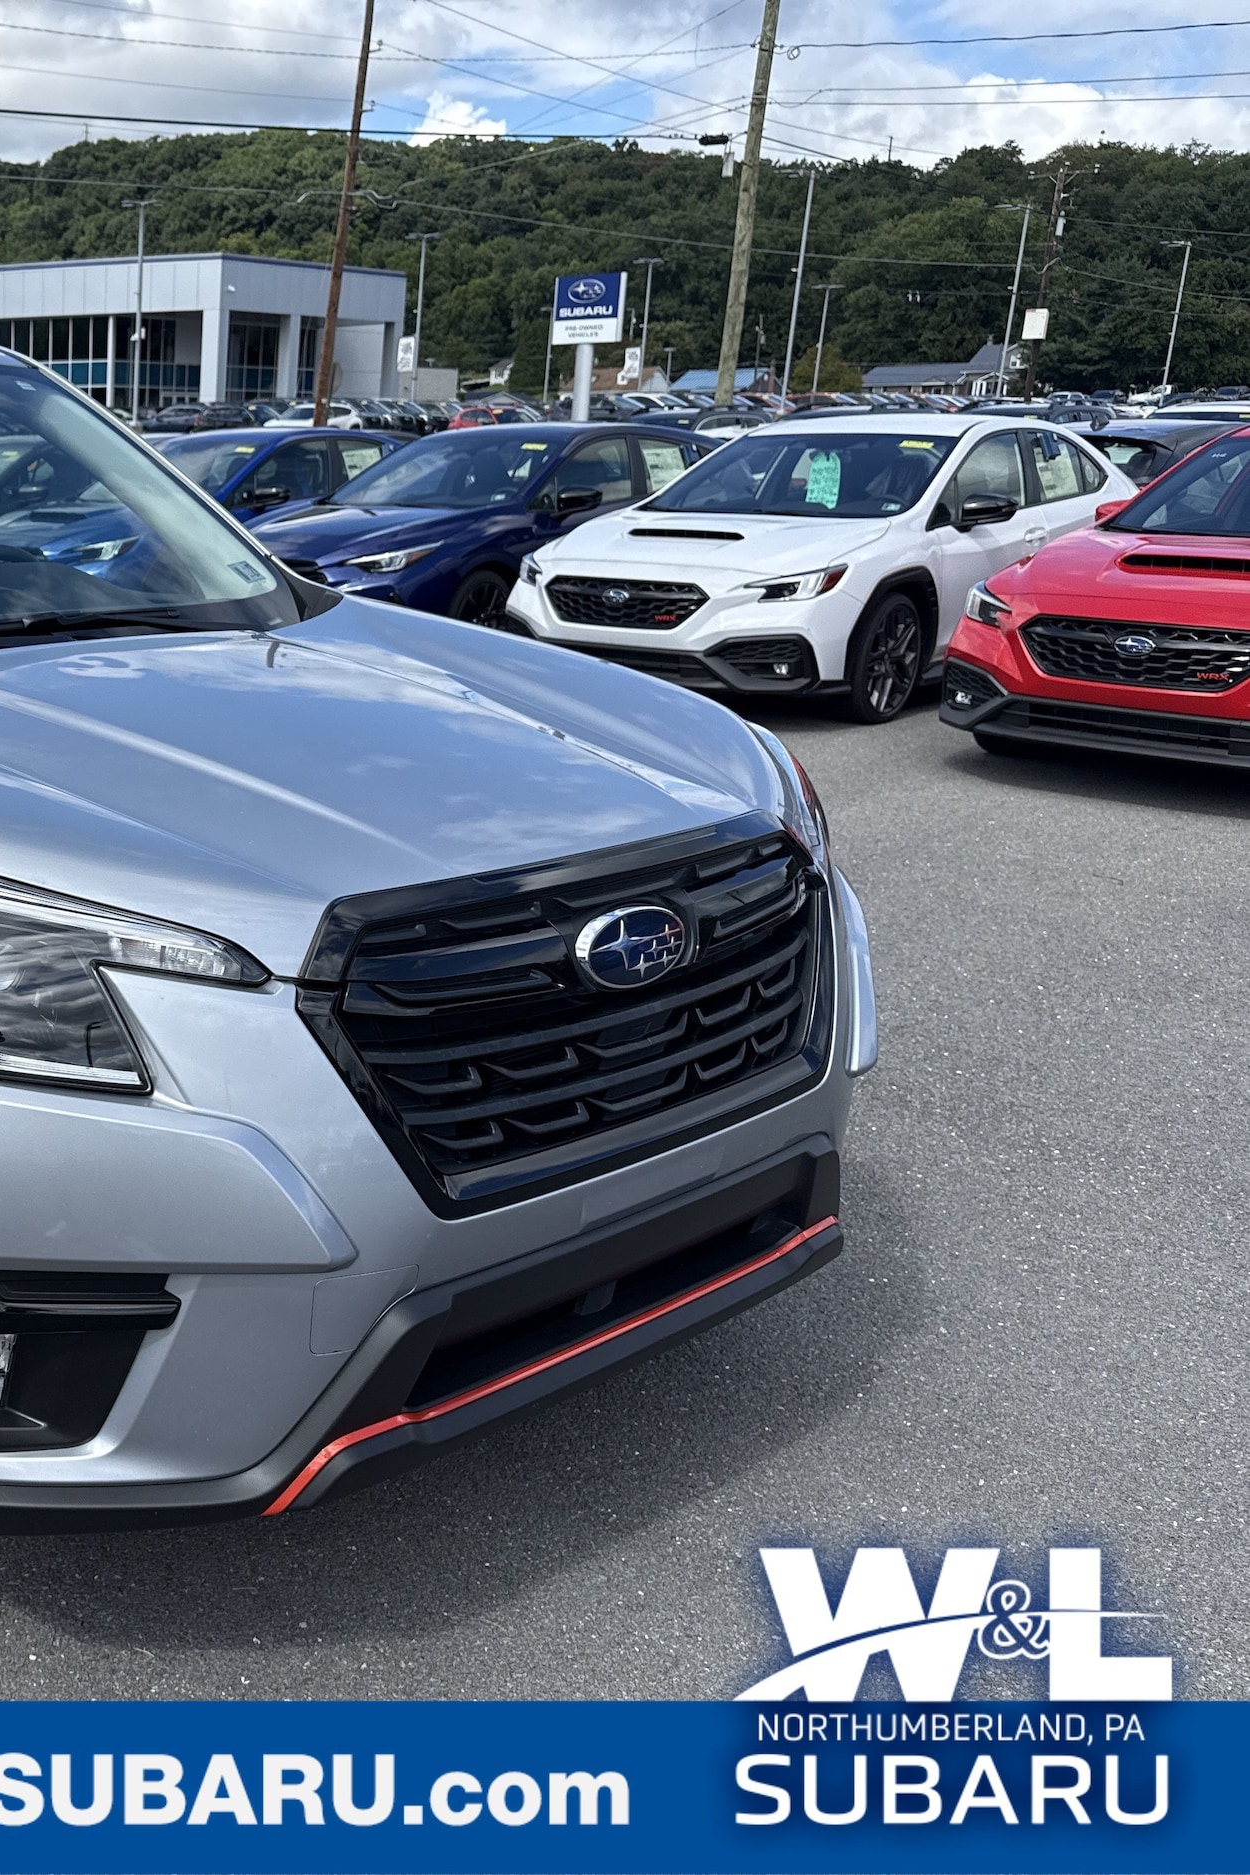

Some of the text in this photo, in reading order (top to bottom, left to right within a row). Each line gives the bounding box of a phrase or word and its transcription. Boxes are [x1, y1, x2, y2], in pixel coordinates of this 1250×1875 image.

[559, 305, 613, 318] SUBARU
[654, 614, 677, 622] WRX
[1196, 672, 1230, 681] WRX
